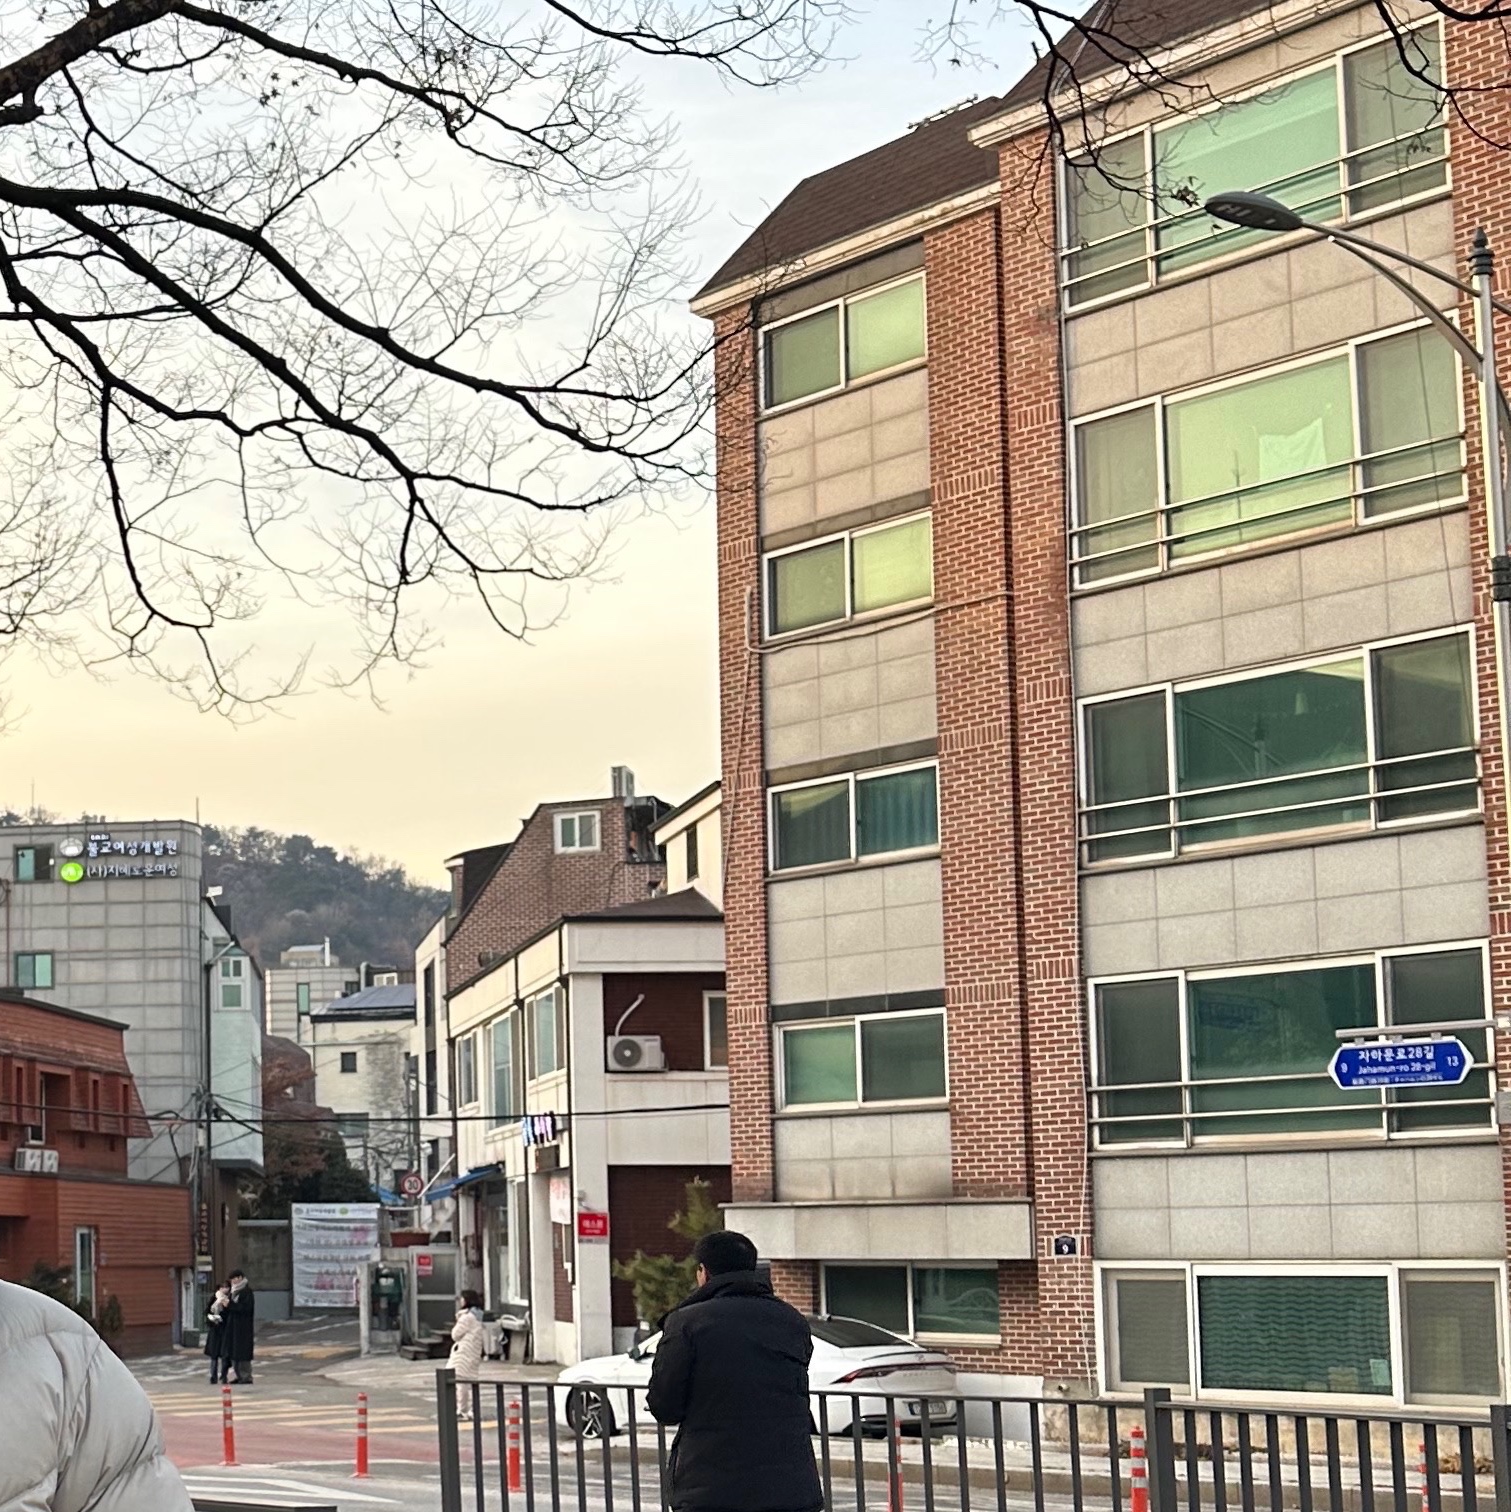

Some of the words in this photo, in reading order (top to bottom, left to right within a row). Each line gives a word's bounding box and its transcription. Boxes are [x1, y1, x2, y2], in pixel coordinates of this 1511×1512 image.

[87, 840, 177, 857] 불교여성개발원
[1358, 1045, 1434, 1063] 자하문로28길
[1447, 1055, 1459, 1067] 13
[1358, 1064, 1410, 1075] Jahamun-ro
[1410, 1061, 1436, 1073] 28-gil
[407, 1179, 419, 1190] 30
[1062, 1244, 1069, 1255] 9
